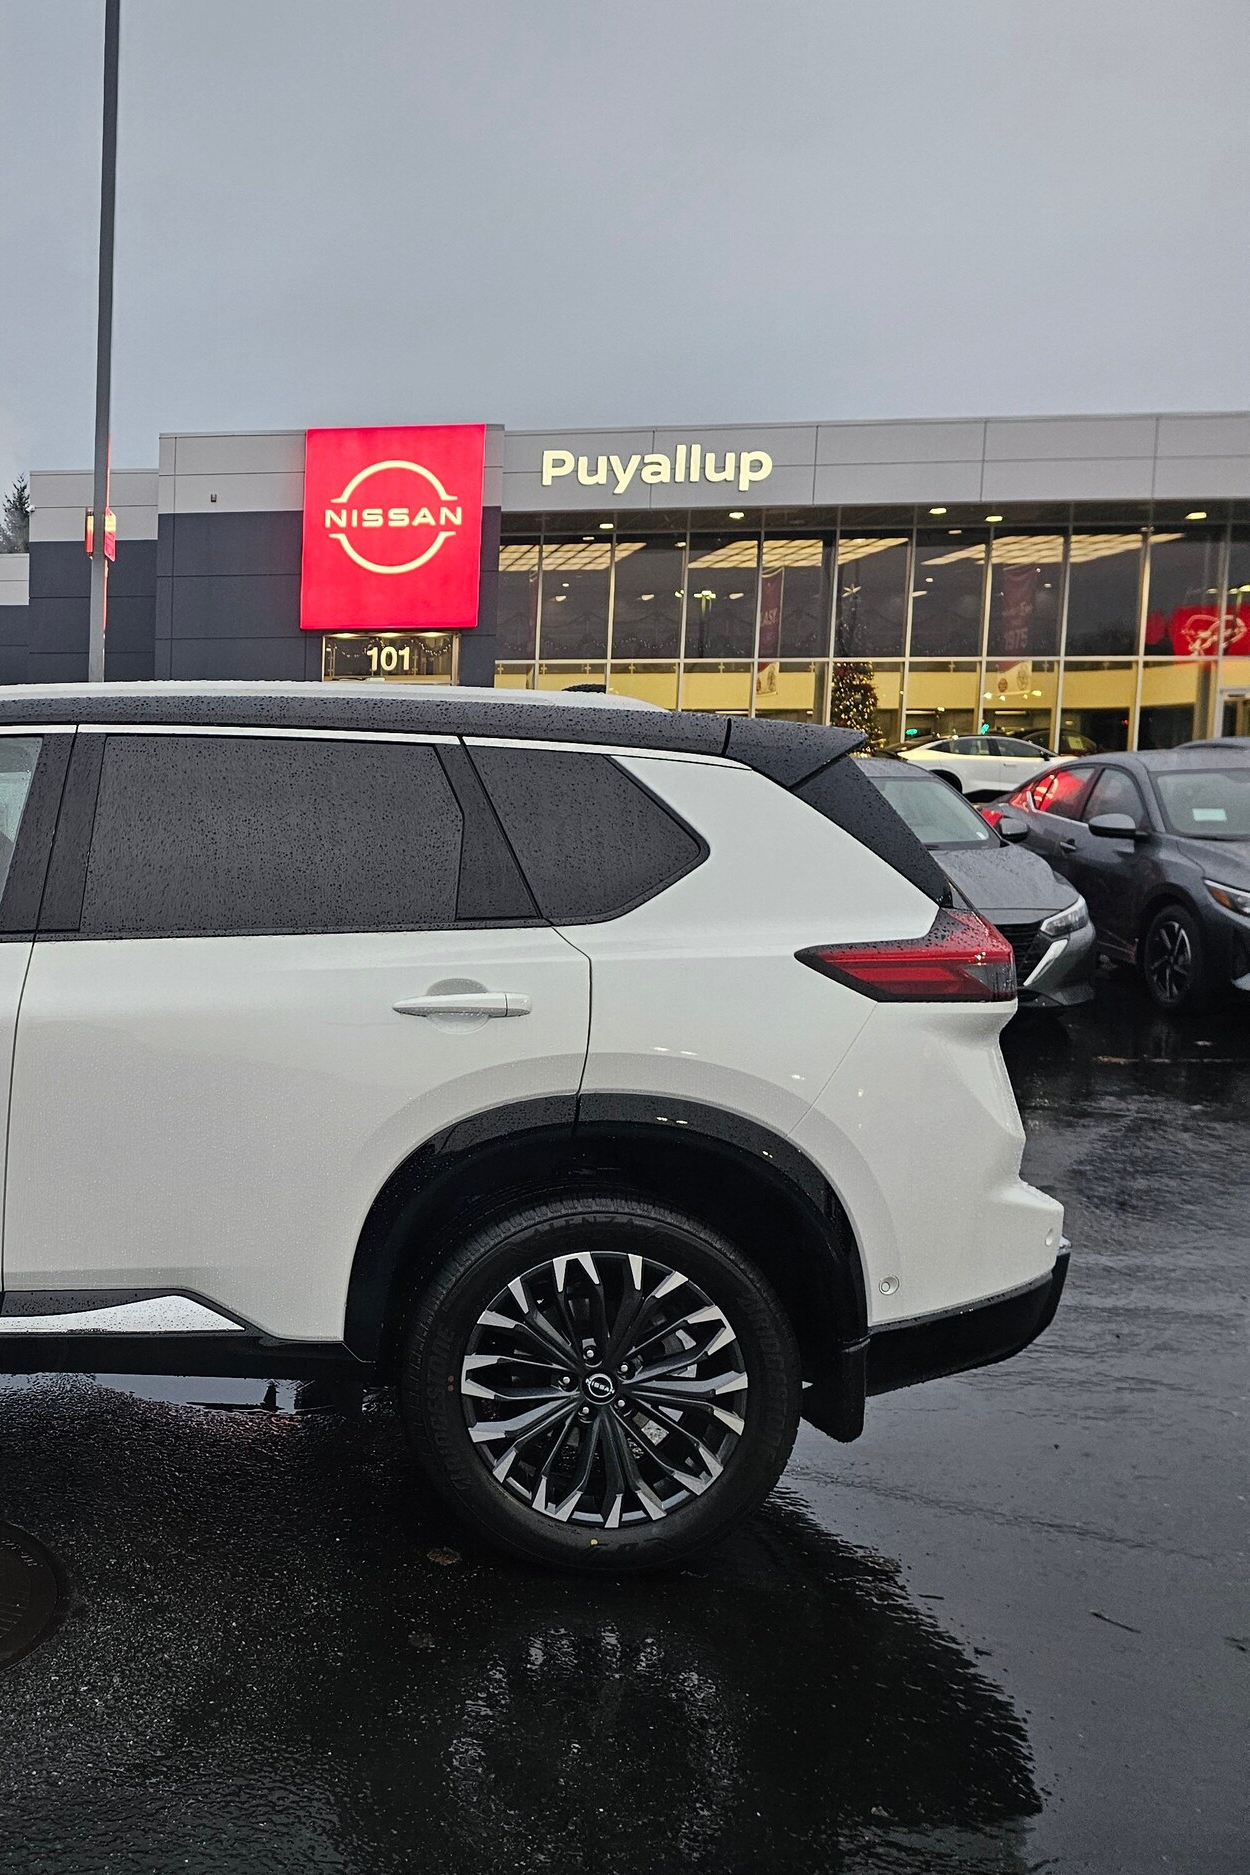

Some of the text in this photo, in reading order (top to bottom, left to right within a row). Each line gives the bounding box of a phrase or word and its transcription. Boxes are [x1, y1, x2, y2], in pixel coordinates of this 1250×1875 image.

[541, 443, 773, 494] Puyallup
[324, 506, 462, 528] NISSAN
[366, 646, 411, 671] 101
[585, 1377, 616, 1394] NISSAN
